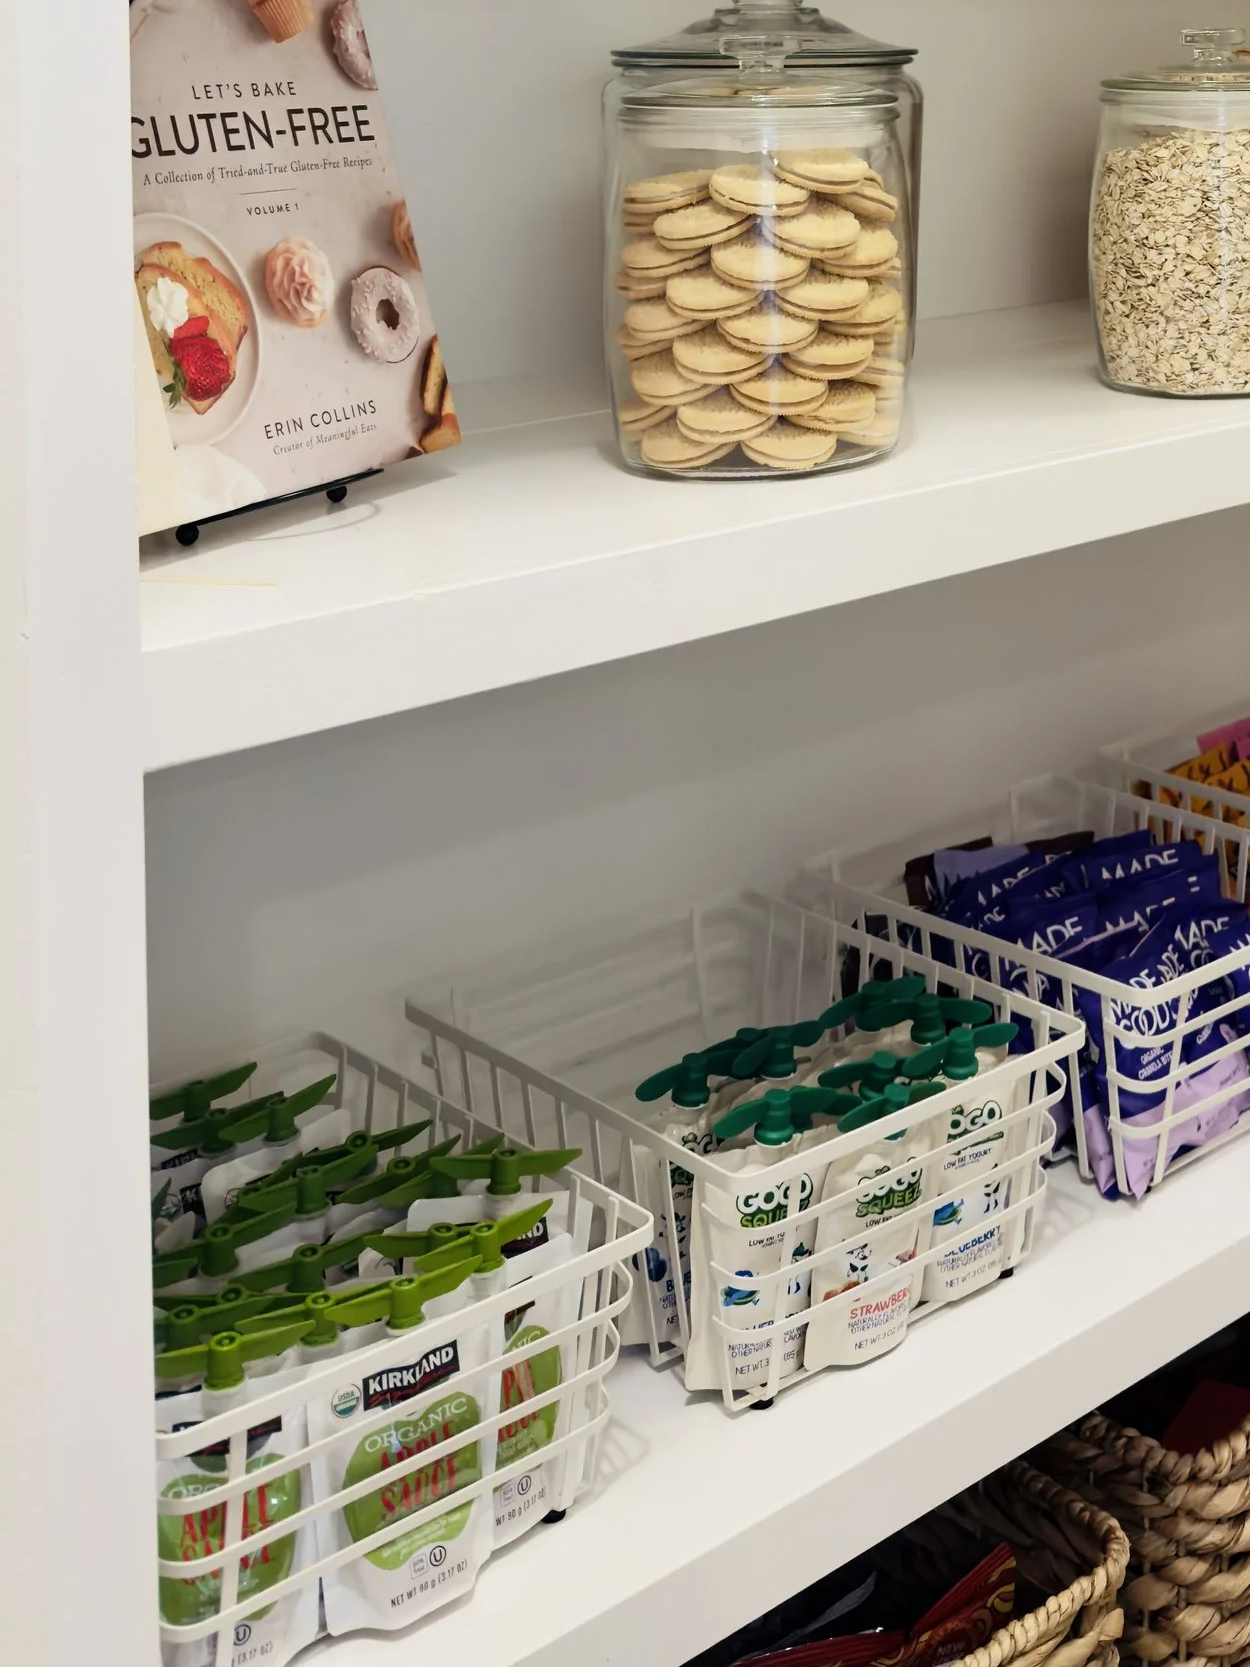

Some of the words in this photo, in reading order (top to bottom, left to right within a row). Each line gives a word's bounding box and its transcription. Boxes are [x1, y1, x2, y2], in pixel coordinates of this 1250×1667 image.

[191, 83, 243, 100] LET'S
[251, 81, 297, 97] BAKE
[131, 104, 376, 159] GLUTEN-FREE
[143, 174, 151, 186] A
[154, 168, 204, 185] Collection
[206, 167, 216, 184] of
[218, 162, 289, 178] Tried-and-True
[290, 158, 341, 173] Gluten-Free
[343, 155, 373, 170] Recipes
[246, 203, 291, 216] VOLUME
[295, 202, 299, 211] 1
[264, 416, 304, 440] ERIN
[310, 399, 377, 428] COLLINS
[273, 442, 304, 455] Creator
[305, 438, 314, 450] of
[316, 425, 359, 446] Meaningful
[360, 422, 378, 434] Eats
[943, 1160, 957, 1171] LOW
[968, 1147, 994, 1163] YOGURT
[865, 1217, 882, 1228] LOW
[945, 1275, 961, 1289] NET
[848, 1314, 883, 1329] NATURALLY
[850, 1322, 869, 1335] OTHER
[854, 1339, 869, 1351] NET
[368, 1345, 455, 1395] KIRKLAND
[735, 1365, 751, 1375] NET
[364, 1397, 468, 1453] ORGANIC
[390, 1593, 405, 1608] NET
[405, 1586, 417, 1601] WT
[418, 1580, 429, 1593] 90
[430, 1578, 436, 1589] g
[437, 1565, 455, 1585] (3.17
[456, 1558, 468, 1574] OZ)
